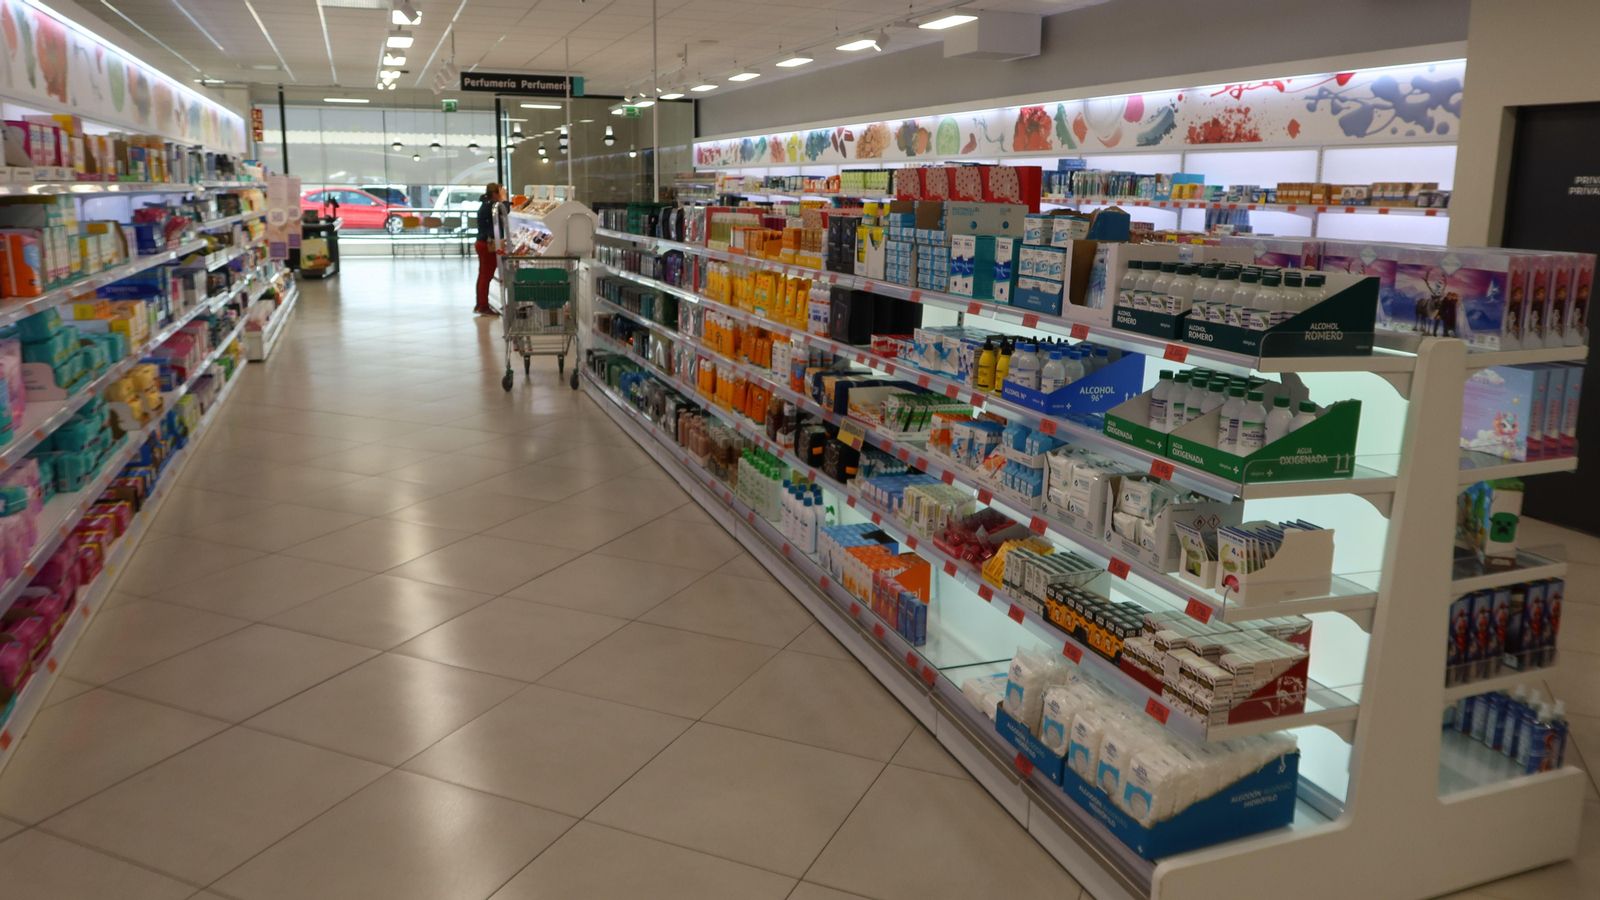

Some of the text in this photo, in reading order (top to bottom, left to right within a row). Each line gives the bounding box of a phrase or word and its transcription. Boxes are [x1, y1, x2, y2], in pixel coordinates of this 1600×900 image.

[464, 77, 517, 90] Perfumería
[1574, 176, 1600, 184] PRIV
[1568, 186, 1600, 195] PRIVA
[1117, 315, 1137, 326] ROMERO
[1188, 324, 1206, 334] ALCOHOL
[1310, 322, 1340, 331] ALCOHOL
[1188, 332, 1214, 343] ROMERO
[1304, 330, 1344, 342] ROMERO
[1079, 386, 1116, 395] ALCOHOL
[1106, 426, 1134, 442] OXIGENADA
[1172, 441, 1184, 451] AGUA
[1296, 447, 1312, 455] AGUA
[1172, 447, 1205, 466] OXIGENADA
[1279, 454, 1329, 466] OXIGENADA
